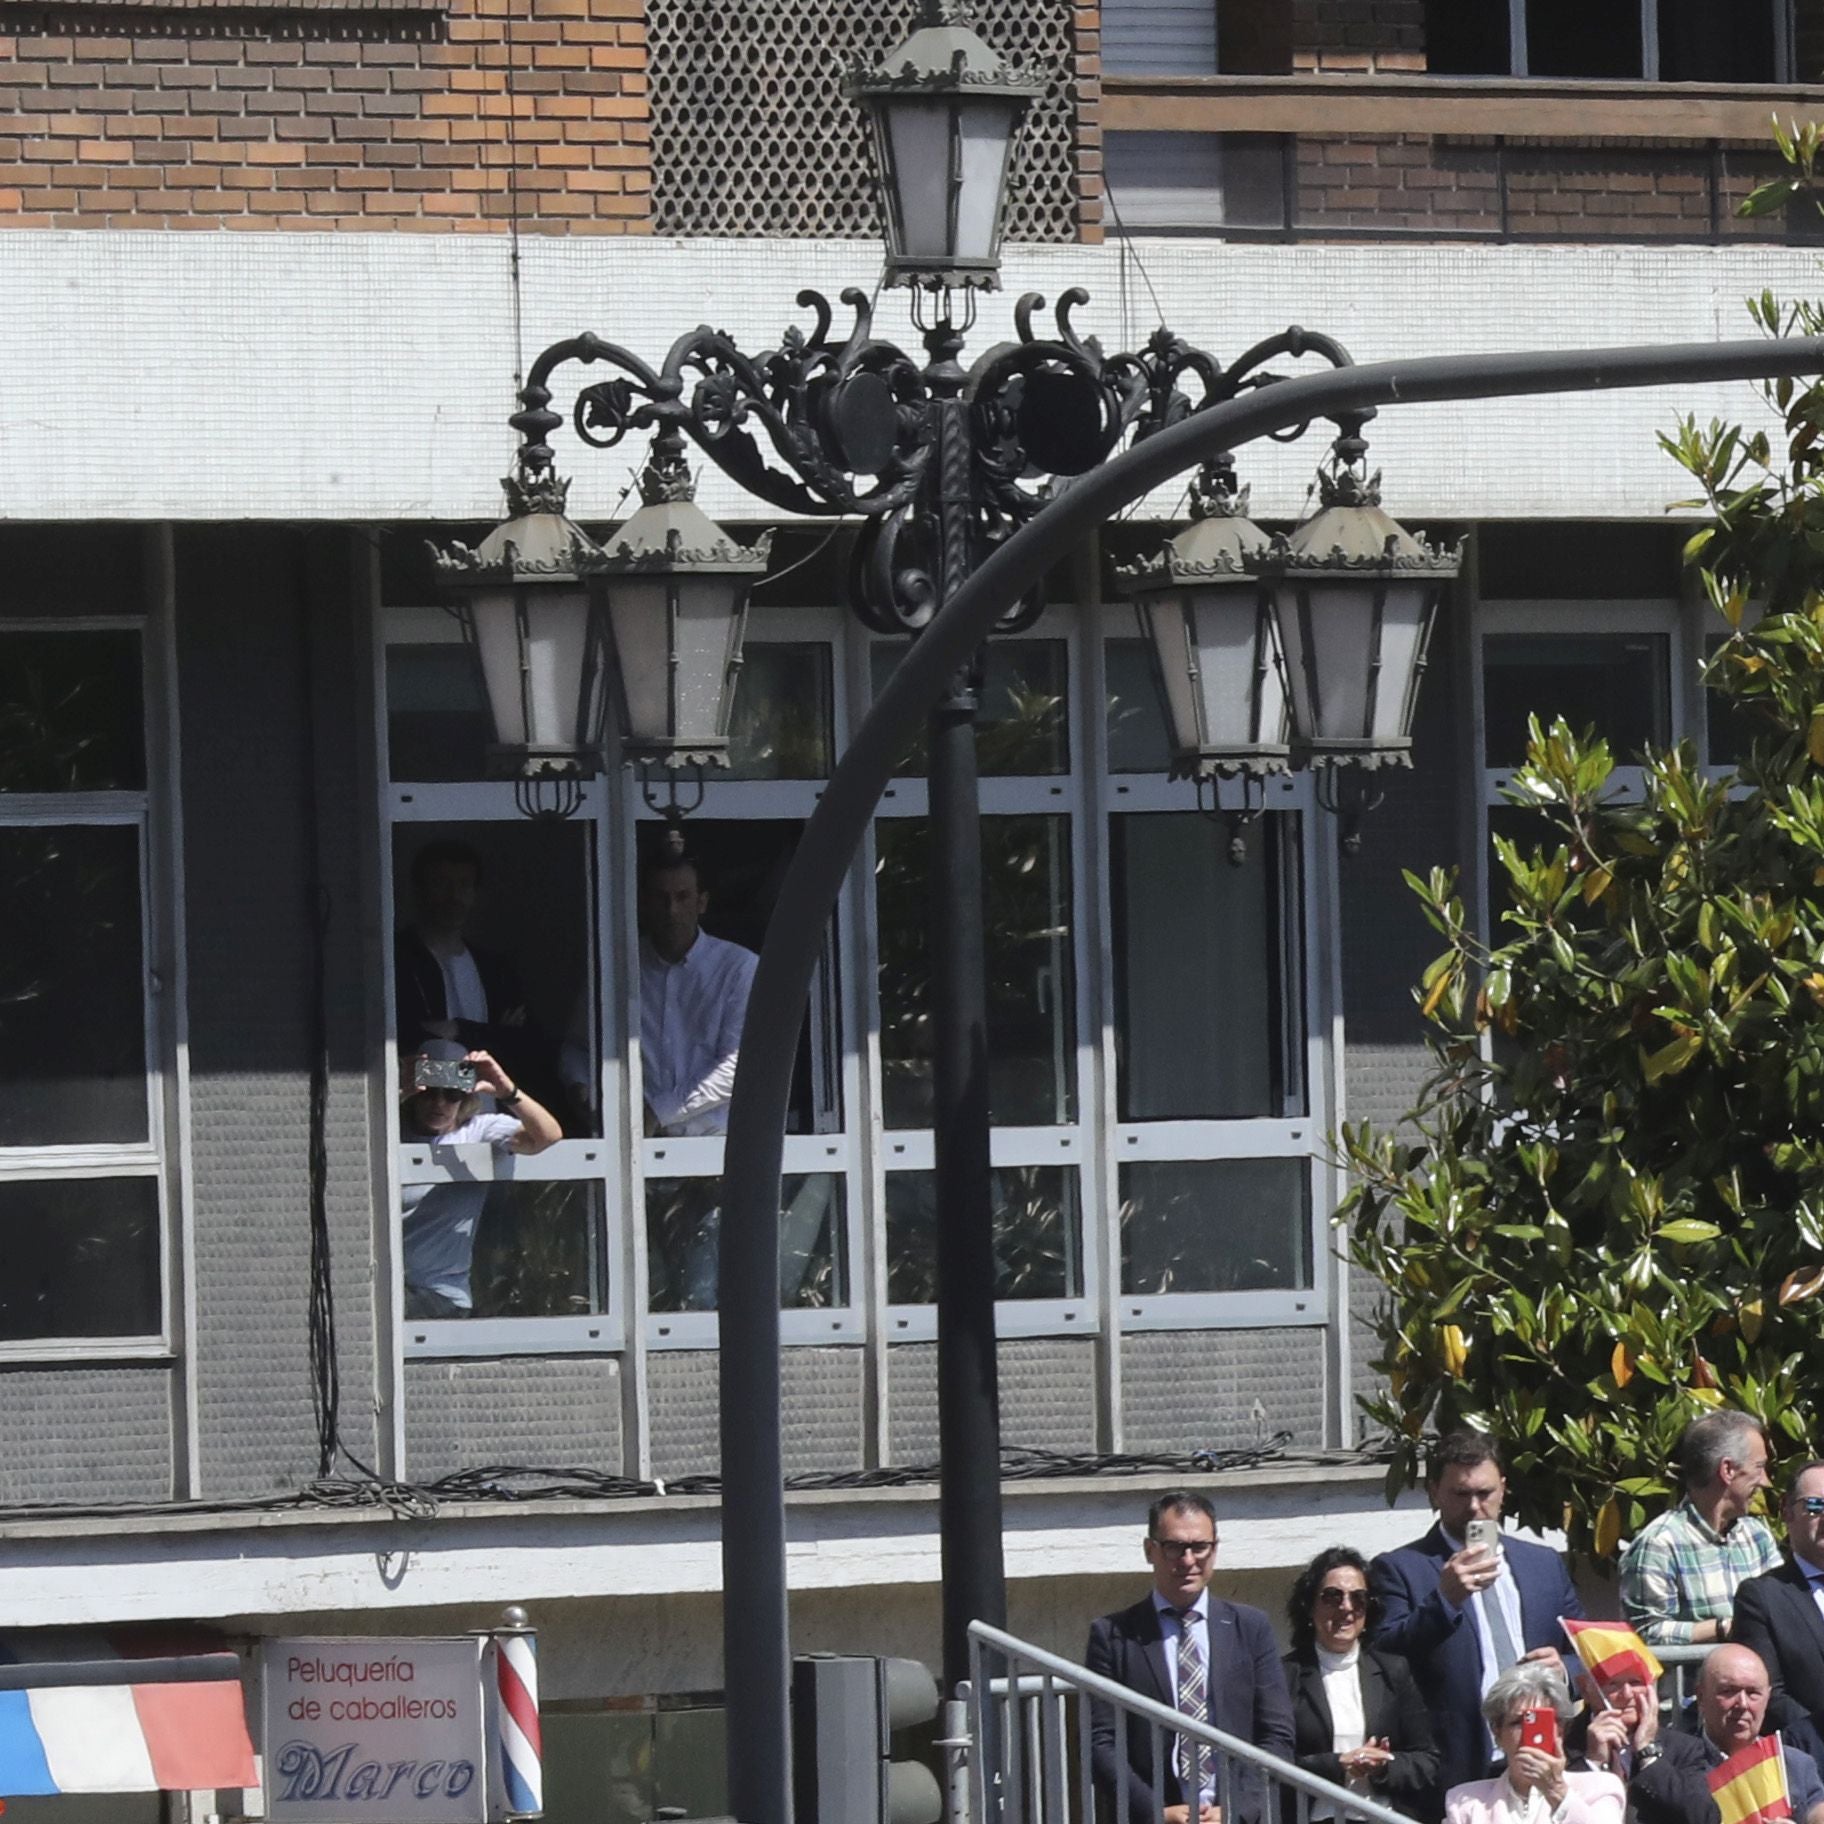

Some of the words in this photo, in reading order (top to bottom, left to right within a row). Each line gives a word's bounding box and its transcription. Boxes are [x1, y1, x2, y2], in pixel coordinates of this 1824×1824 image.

[287, 1655, 414, 1687] Peluquería
[287, 1696, 321, 1720] de
[329, 1696, 457, 1720] caballeros
[274, 1739, 476, 1801] Marco
